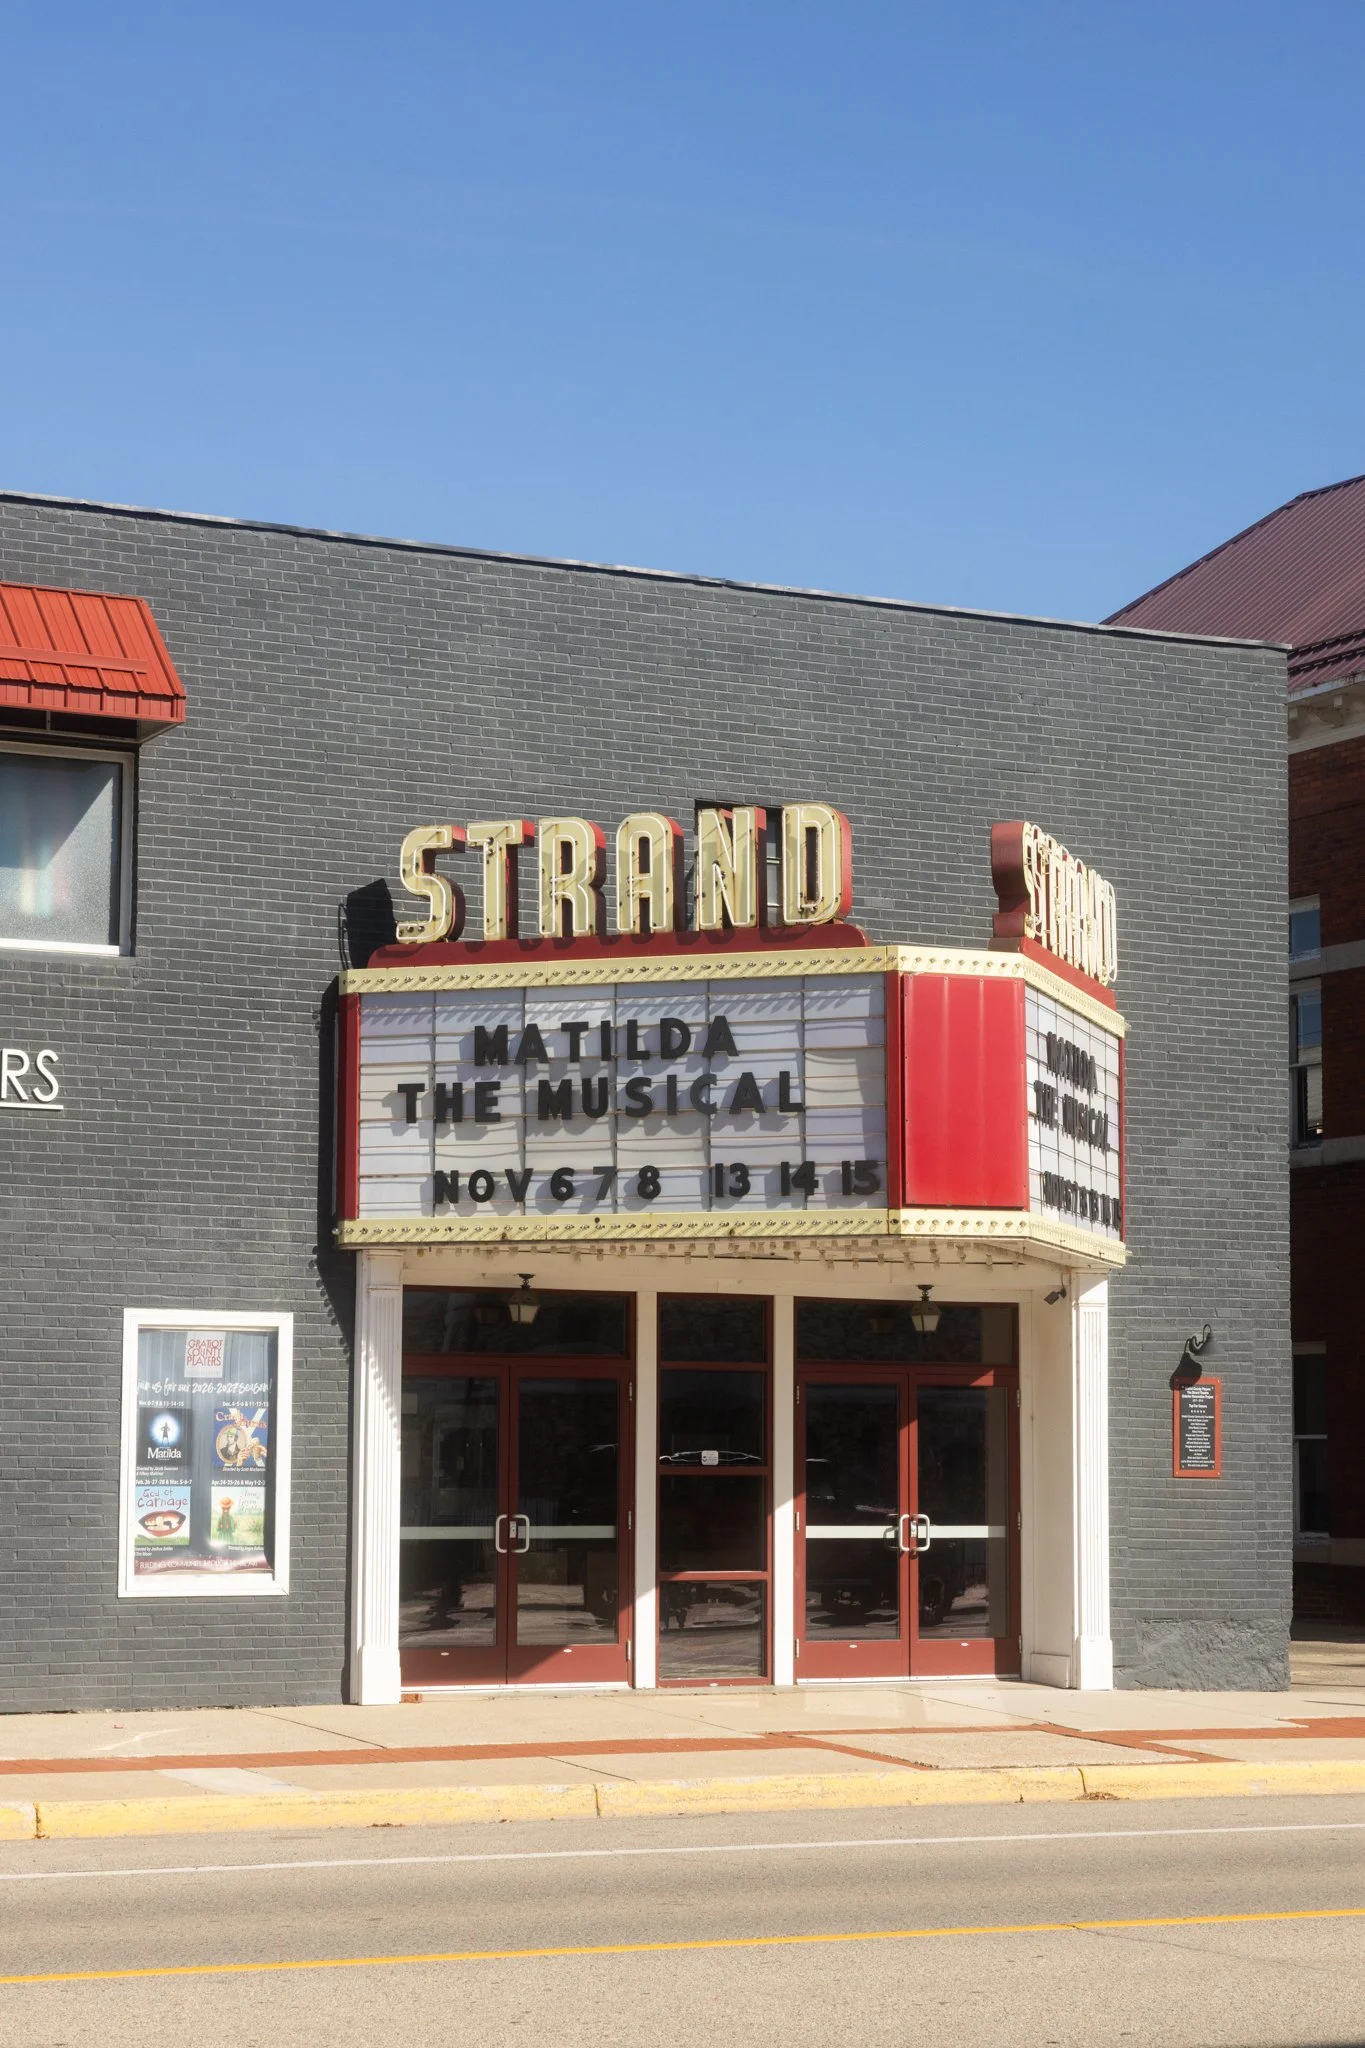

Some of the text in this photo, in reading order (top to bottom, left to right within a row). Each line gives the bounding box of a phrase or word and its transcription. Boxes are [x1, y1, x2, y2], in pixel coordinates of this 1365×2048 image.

[396, 802, 851, 944] STRAND
[474, 1015, 739, 1067] MATILDA
[397, 1070, 803, 1125] THE MUSICAL
[434, 1159, 881, 1205] NOV 6 7 8 13 14 15
[188, 1339, 223, 1349] GRATIOT
[187, 1356, 221, 1366] PLAYERS
[147, 1447, 182, 1459] Matilda
[143, 1489, 160, 1498] God
[137, 1497, 188, 1510] Carnage
